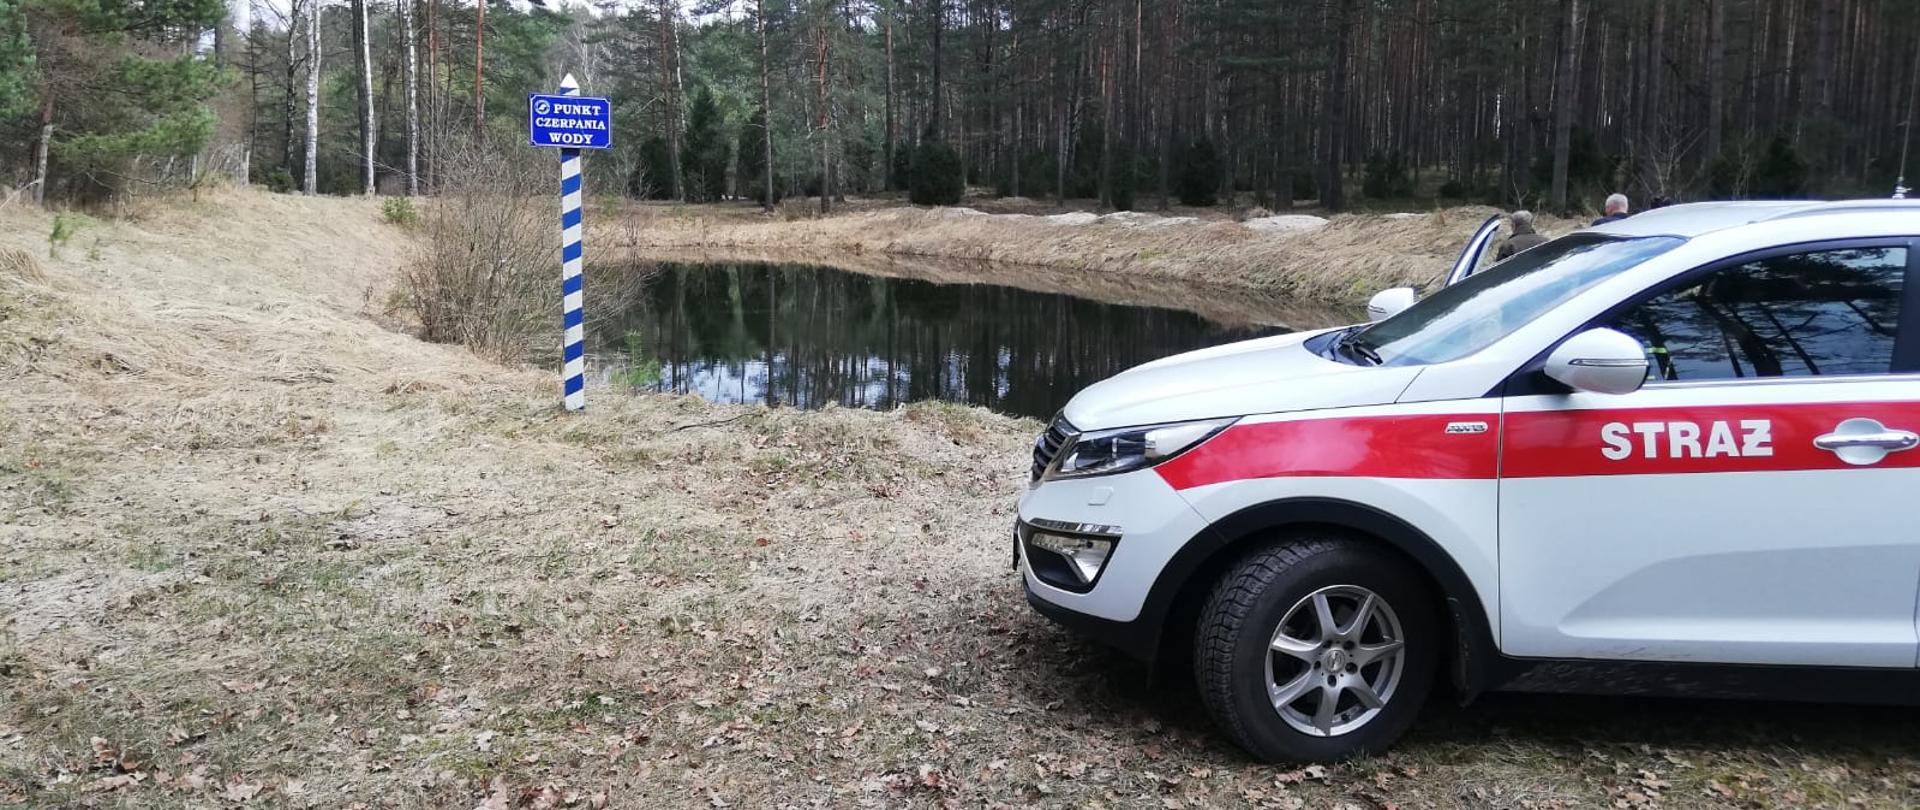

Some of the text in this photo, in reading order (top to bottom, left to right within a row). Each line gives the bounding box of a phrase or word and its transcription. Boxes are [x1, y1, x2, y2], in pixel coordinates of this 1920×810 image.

[554, 104, 601, 115] PUNKT
[535, 117, 606, 130] CZERPANIA
[549, 132, 594, 144] WODY
